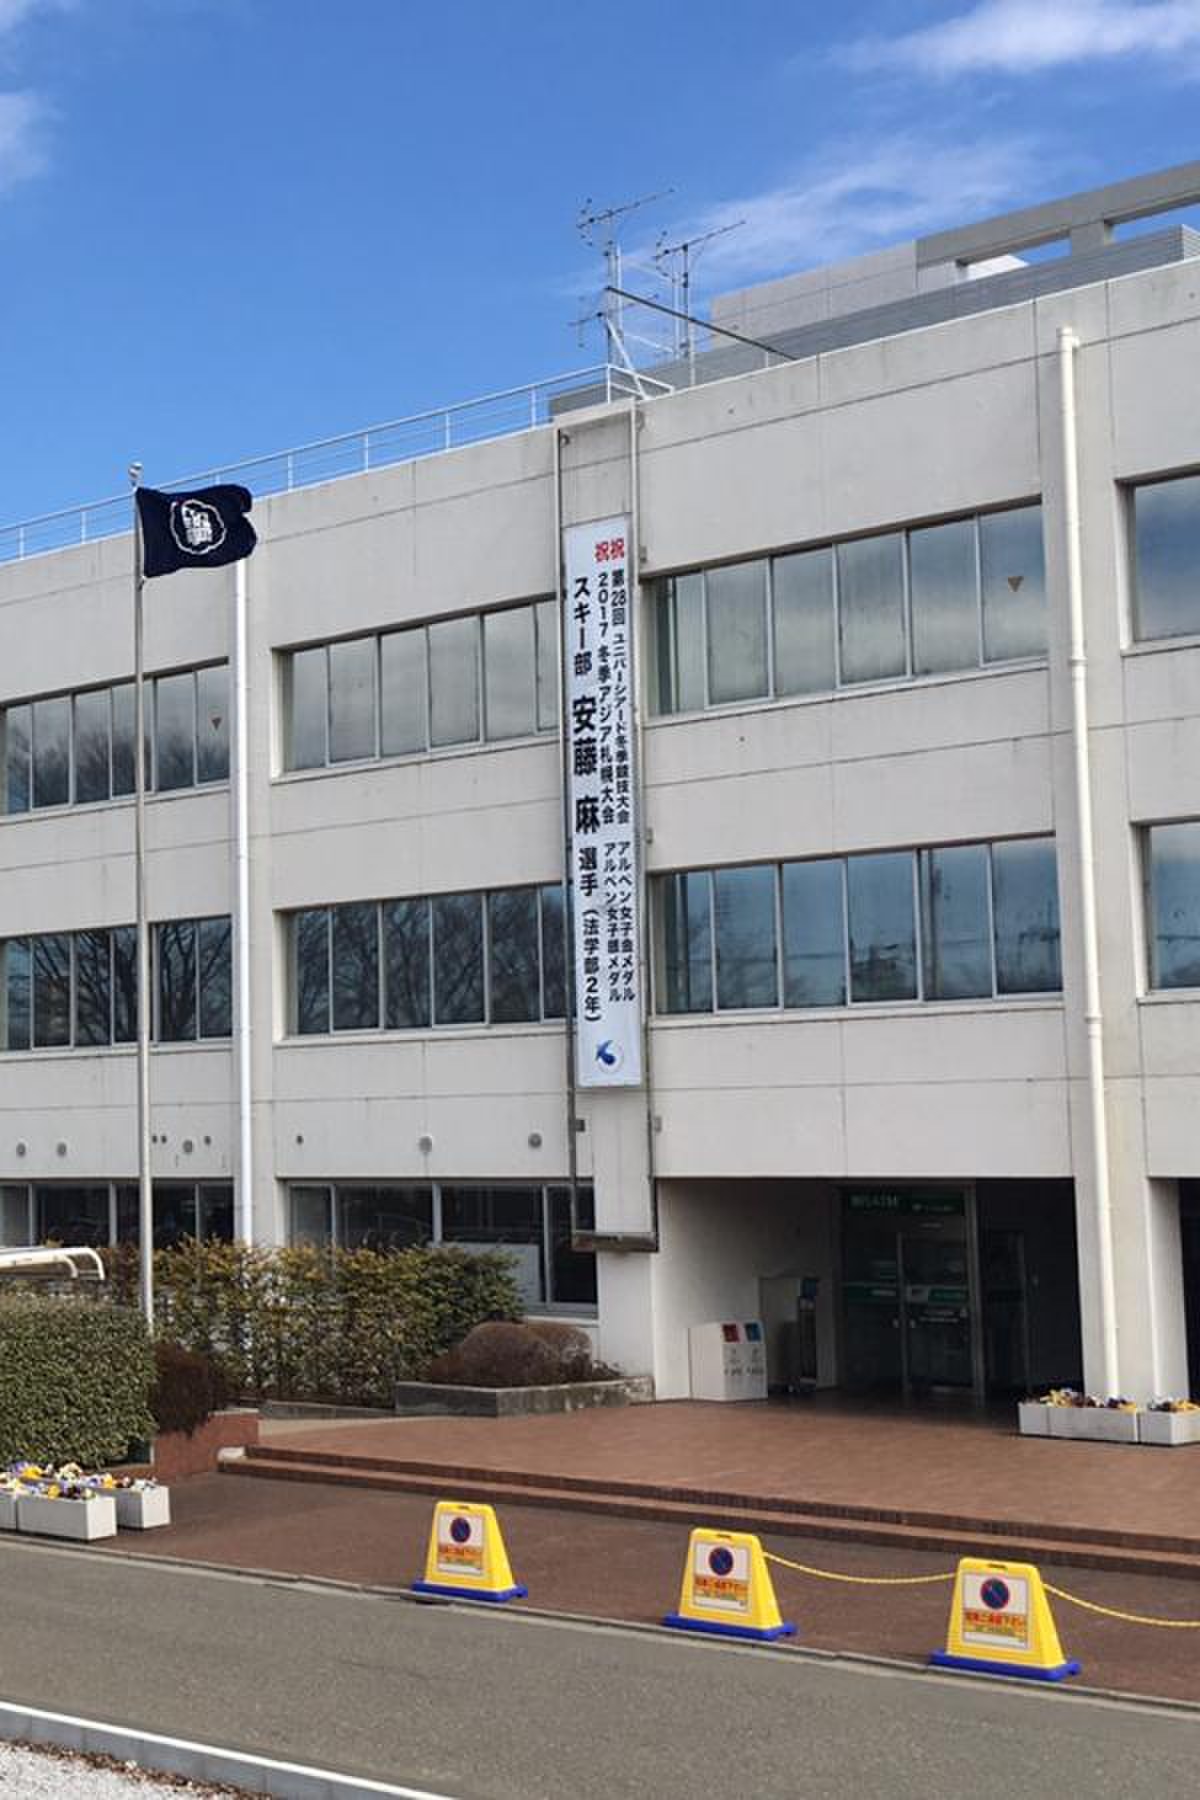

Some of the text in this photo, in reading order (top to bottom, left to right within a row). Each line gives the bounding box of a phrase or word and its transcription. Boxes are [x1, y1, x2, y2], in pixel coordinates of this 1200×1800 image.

[595, 540, 610, 563] 祝
[610, 537, 625, 561] 祝
[573, 576, 593, 677] スキー部
[597, 572, 609, 638] 2017
[578, 846, 599, 897] 選手
